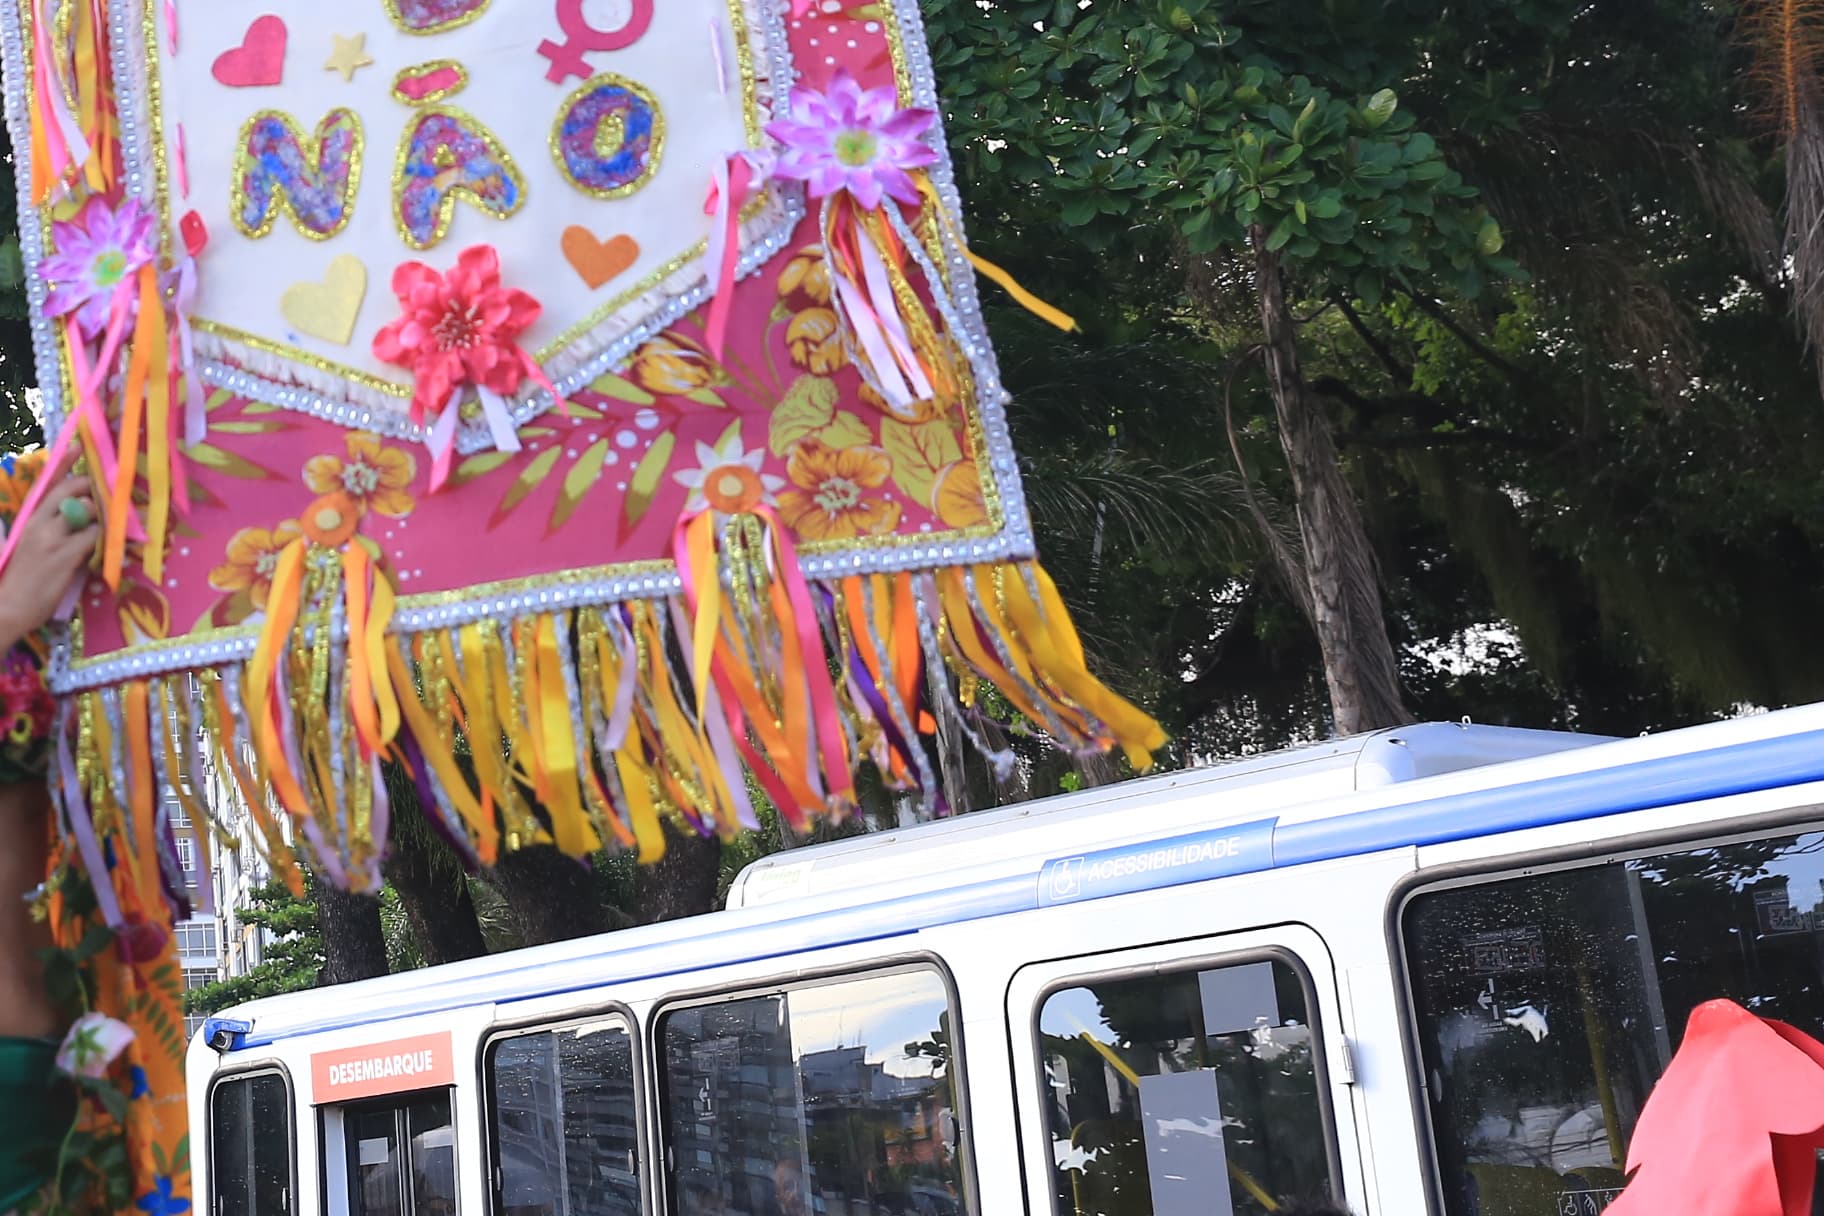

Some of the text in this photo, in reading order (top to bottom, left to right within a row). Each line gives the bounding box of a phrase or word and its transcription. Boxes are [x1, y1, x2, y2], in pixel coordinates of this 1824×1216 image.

[230, 59, 667, 249] NÃO
[1087, 836, 1241, 882] ACESSIBILIDADE
[329, 1050, 433, 1086] DESEMBARQUE
